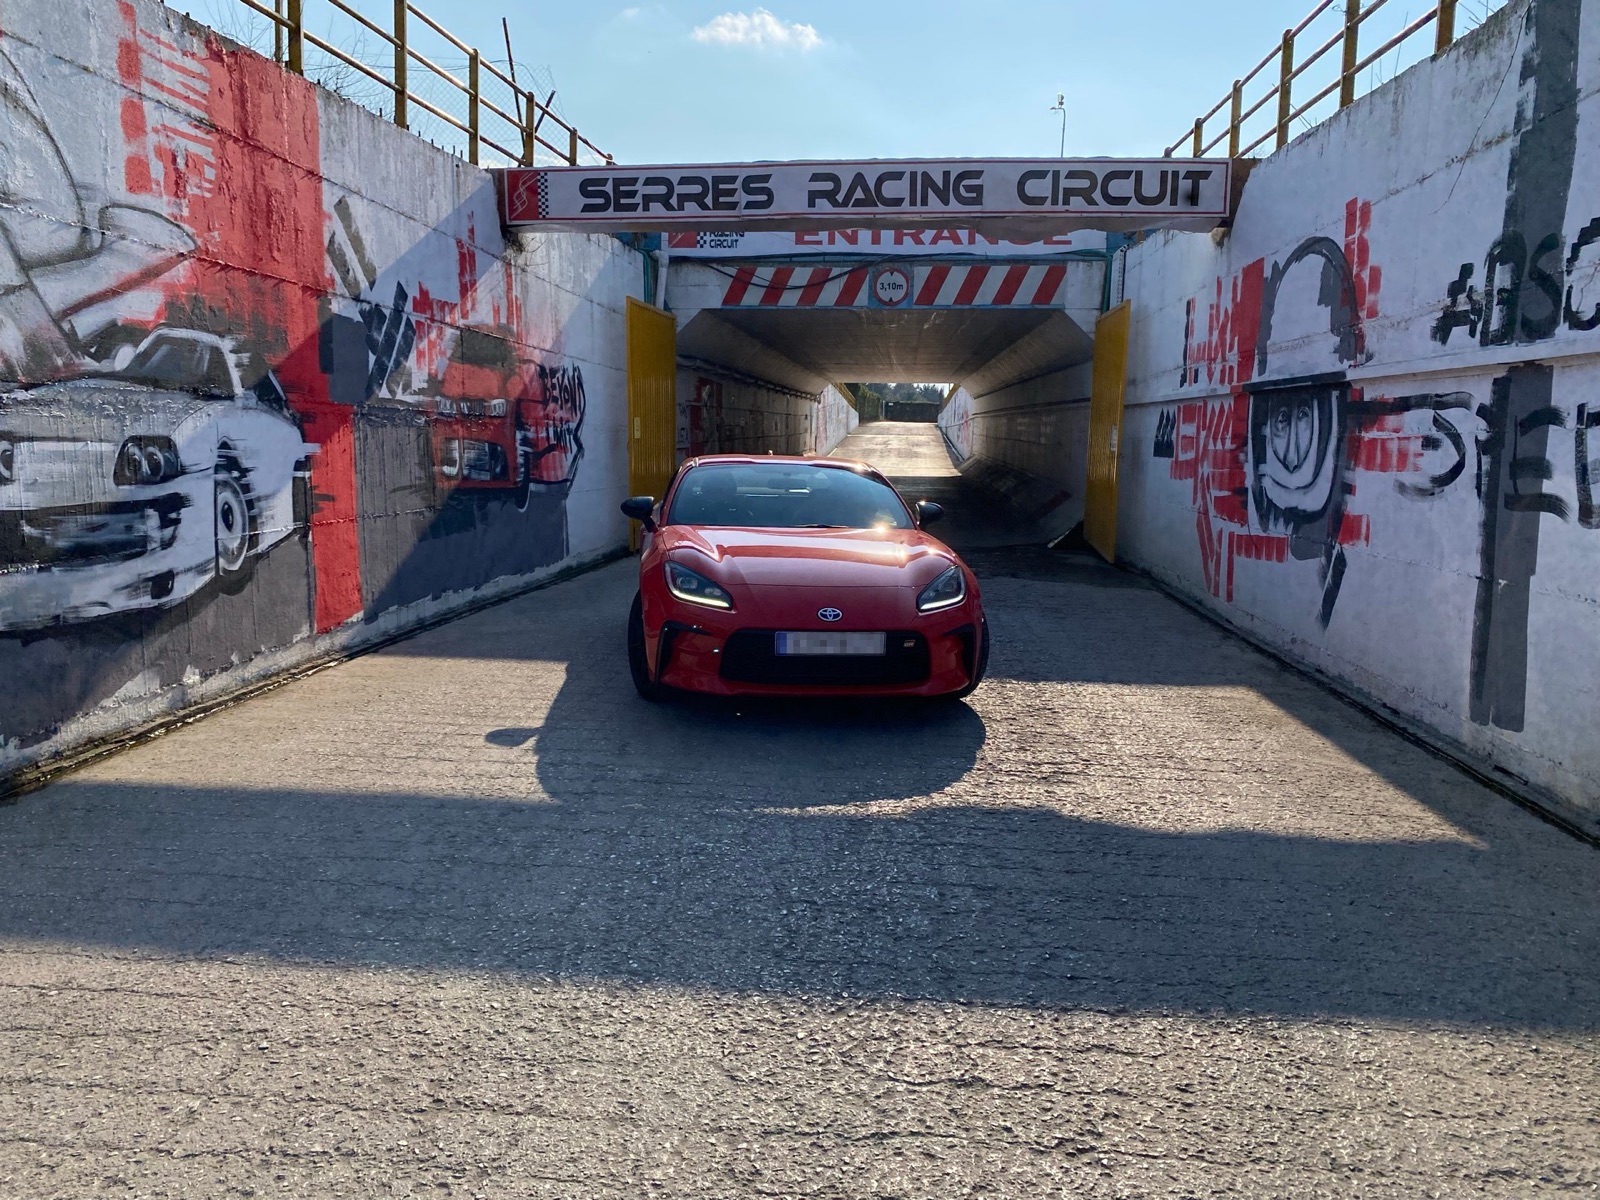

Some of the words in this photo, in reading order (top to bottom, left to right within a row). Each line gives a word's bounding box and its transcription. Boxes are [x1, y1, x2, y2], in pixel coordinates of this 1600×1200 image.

[579, 173, 775, 213] SERRES
[807, 170, 985, 209] RACING
[1016, 169, 1213, 207] CIRCUIT
[709, 238, 739, 249] CIRCUIT
[880, 282, 904, 291] 3,10m
